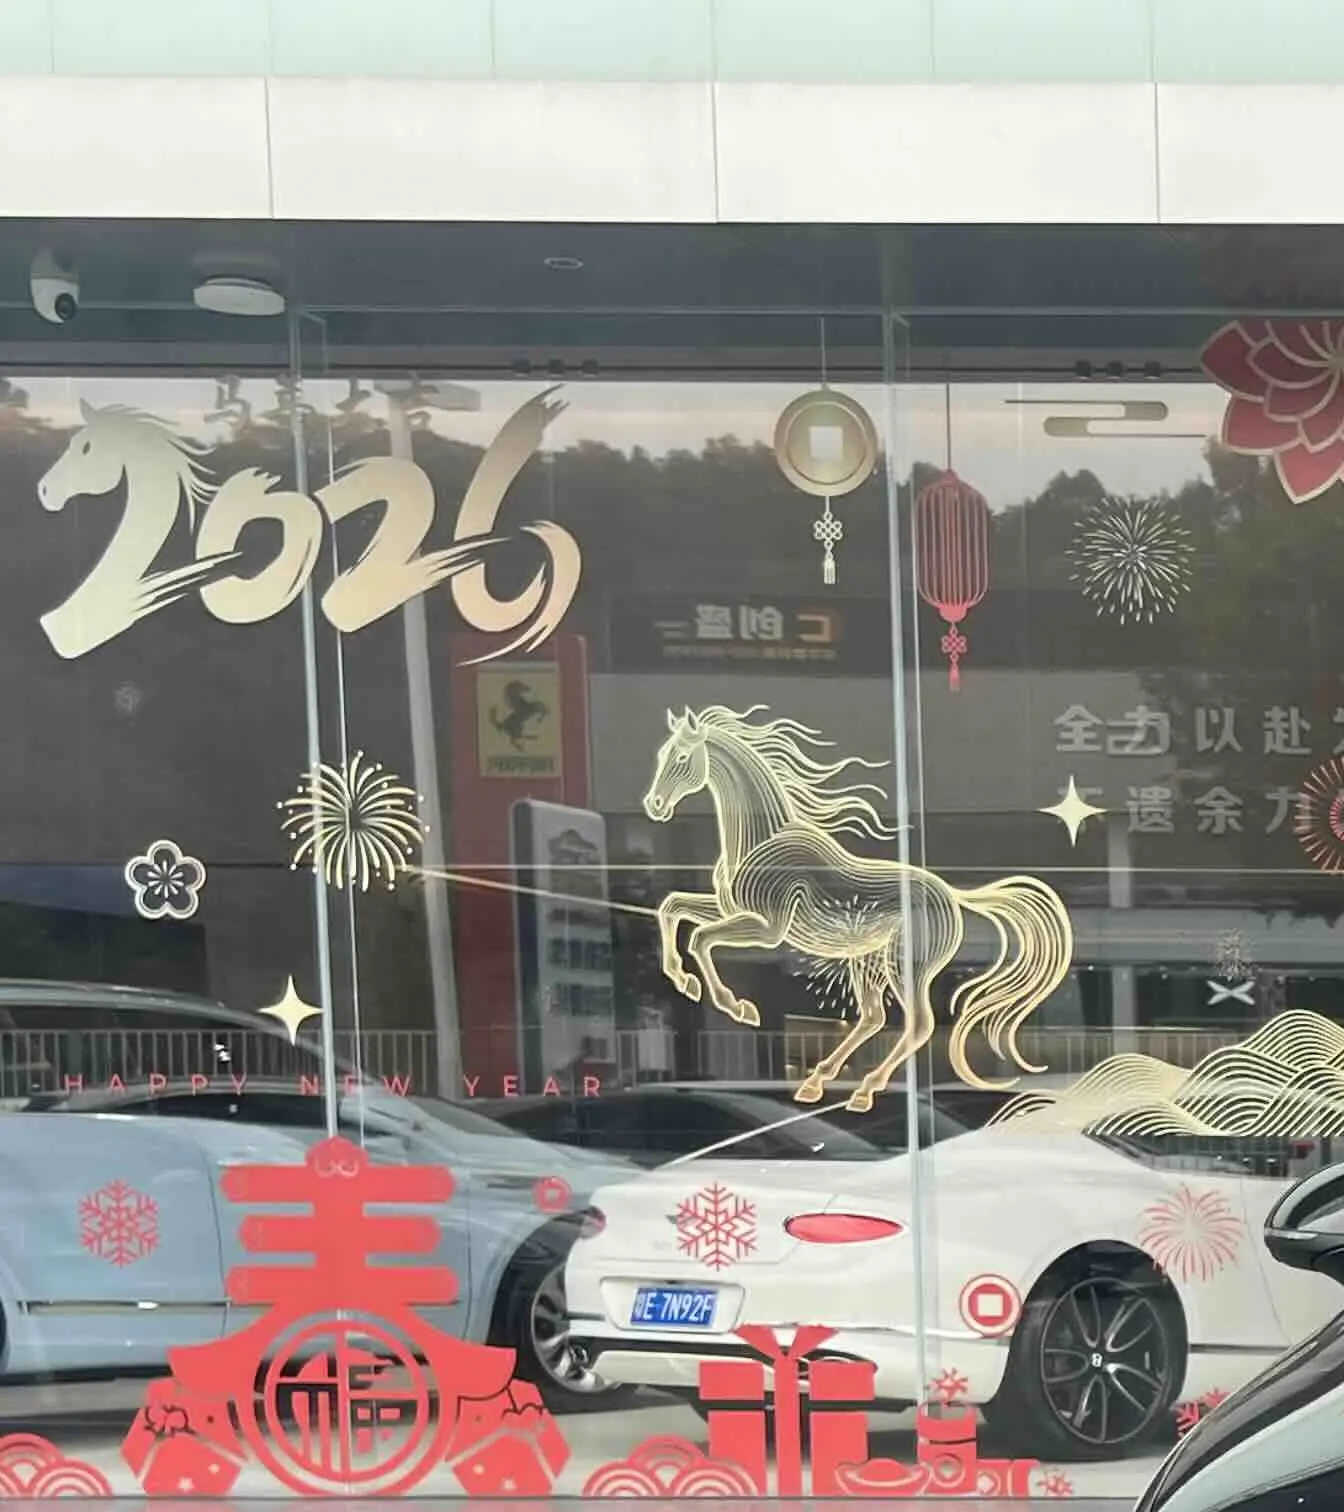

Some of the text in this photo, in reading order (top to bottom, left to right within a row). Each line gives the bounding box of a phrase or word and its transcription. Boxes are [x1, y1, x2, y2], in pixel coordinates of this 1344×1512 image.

[38, 383, 583, 668] 2026
[64, 1073, 602, 1097] HAPPY NEW YEAR
